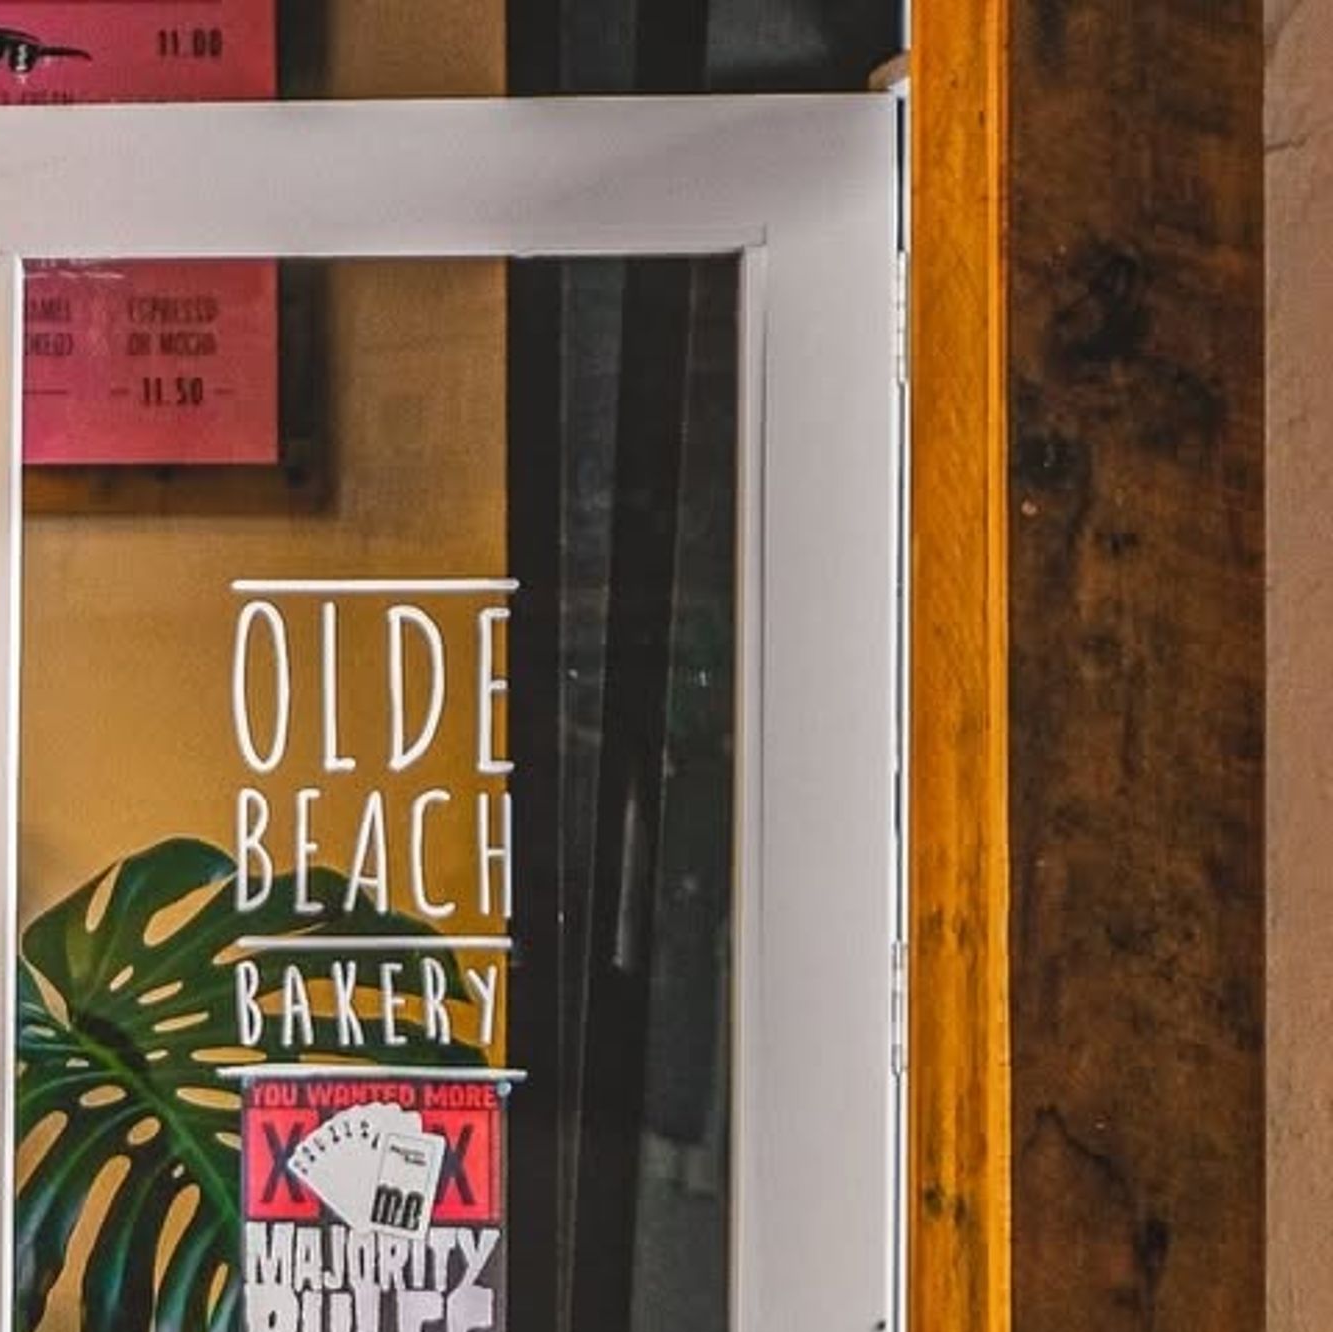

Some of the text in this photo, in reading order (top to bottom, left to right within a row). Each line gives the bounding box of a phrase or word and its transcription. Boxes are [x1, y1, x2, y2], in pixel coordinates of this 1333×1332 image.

[159, 29, 222, 58] 11.00
[143, 377, 203, 406] 11.50
[232, 600, 516, 774] OLDE
[235, 788, 512, 919] BEACH
[236, 957, 499, 1049] BAKERY
[252, 1083, 497, 1106] YOU WANTED MORE
[246, 1222, 500, 1293] MAJORITY
